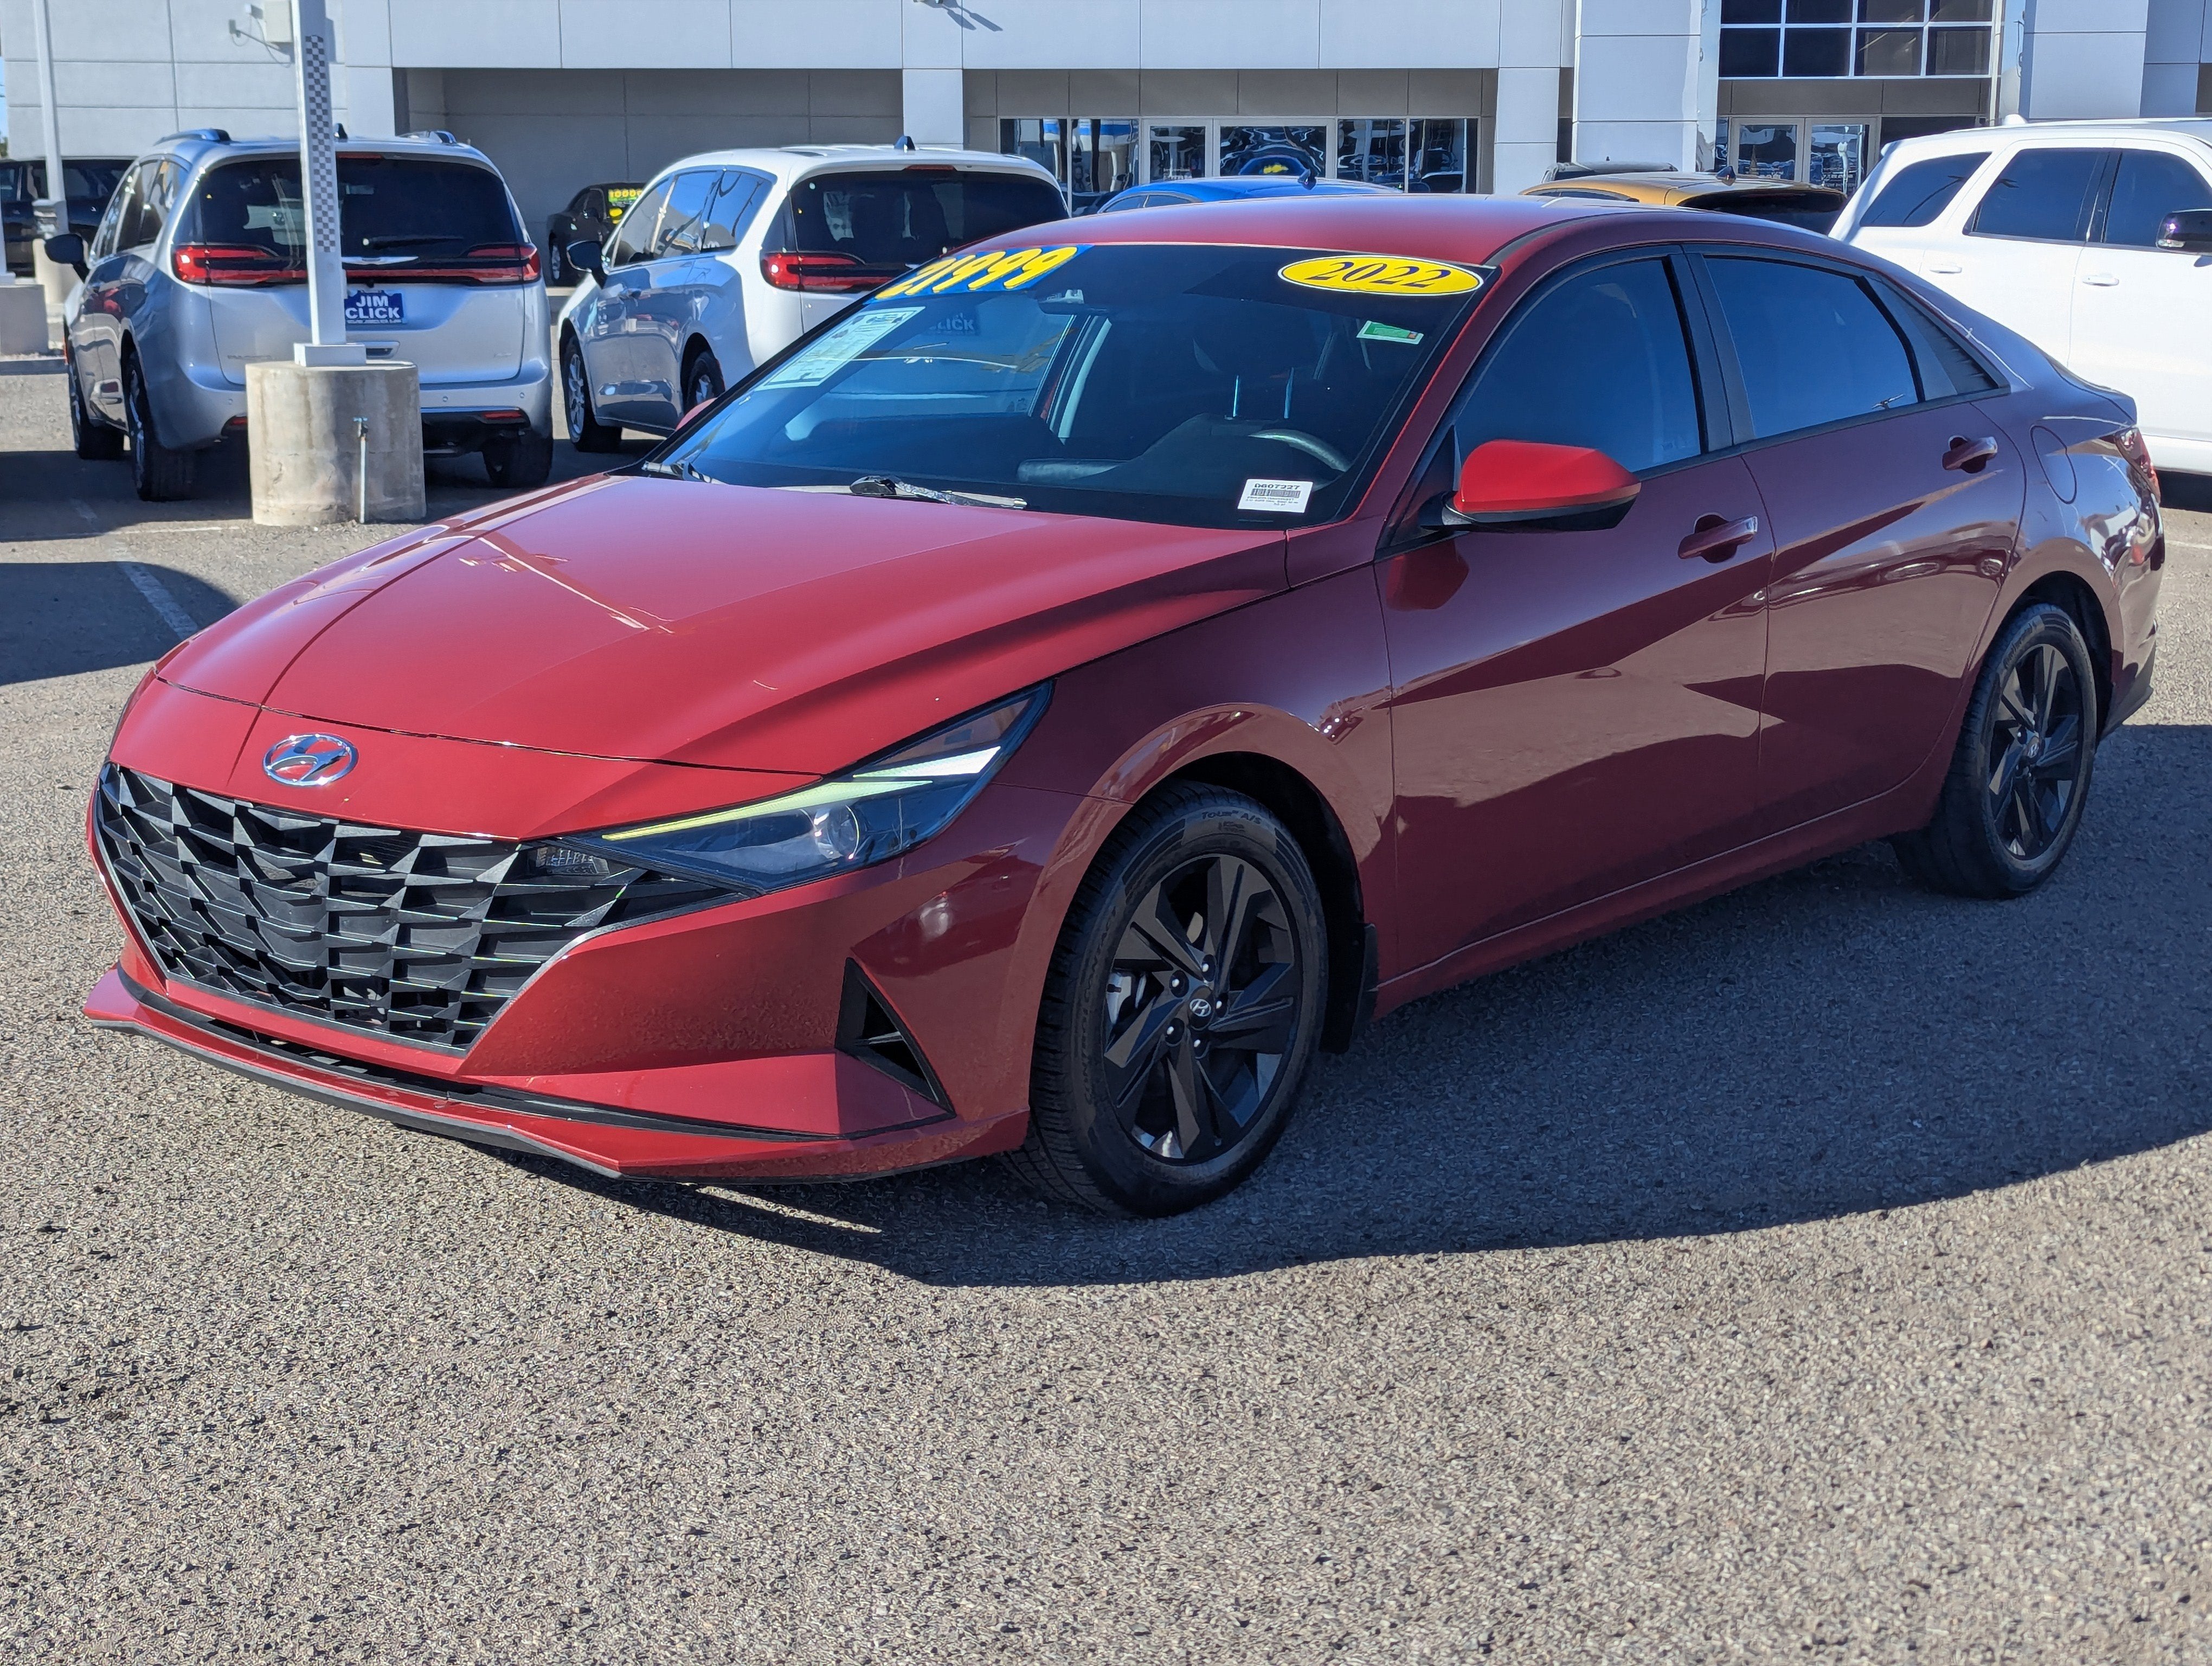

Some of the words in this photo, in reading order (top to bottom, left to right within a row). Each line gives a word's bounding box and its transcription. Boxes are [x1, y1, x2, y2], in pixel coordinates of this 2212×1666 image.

[1304, 261, 1451, 288] 2022
[356, 296, 388, 307] JIM
[345, 307, 400, 319] CLICK
